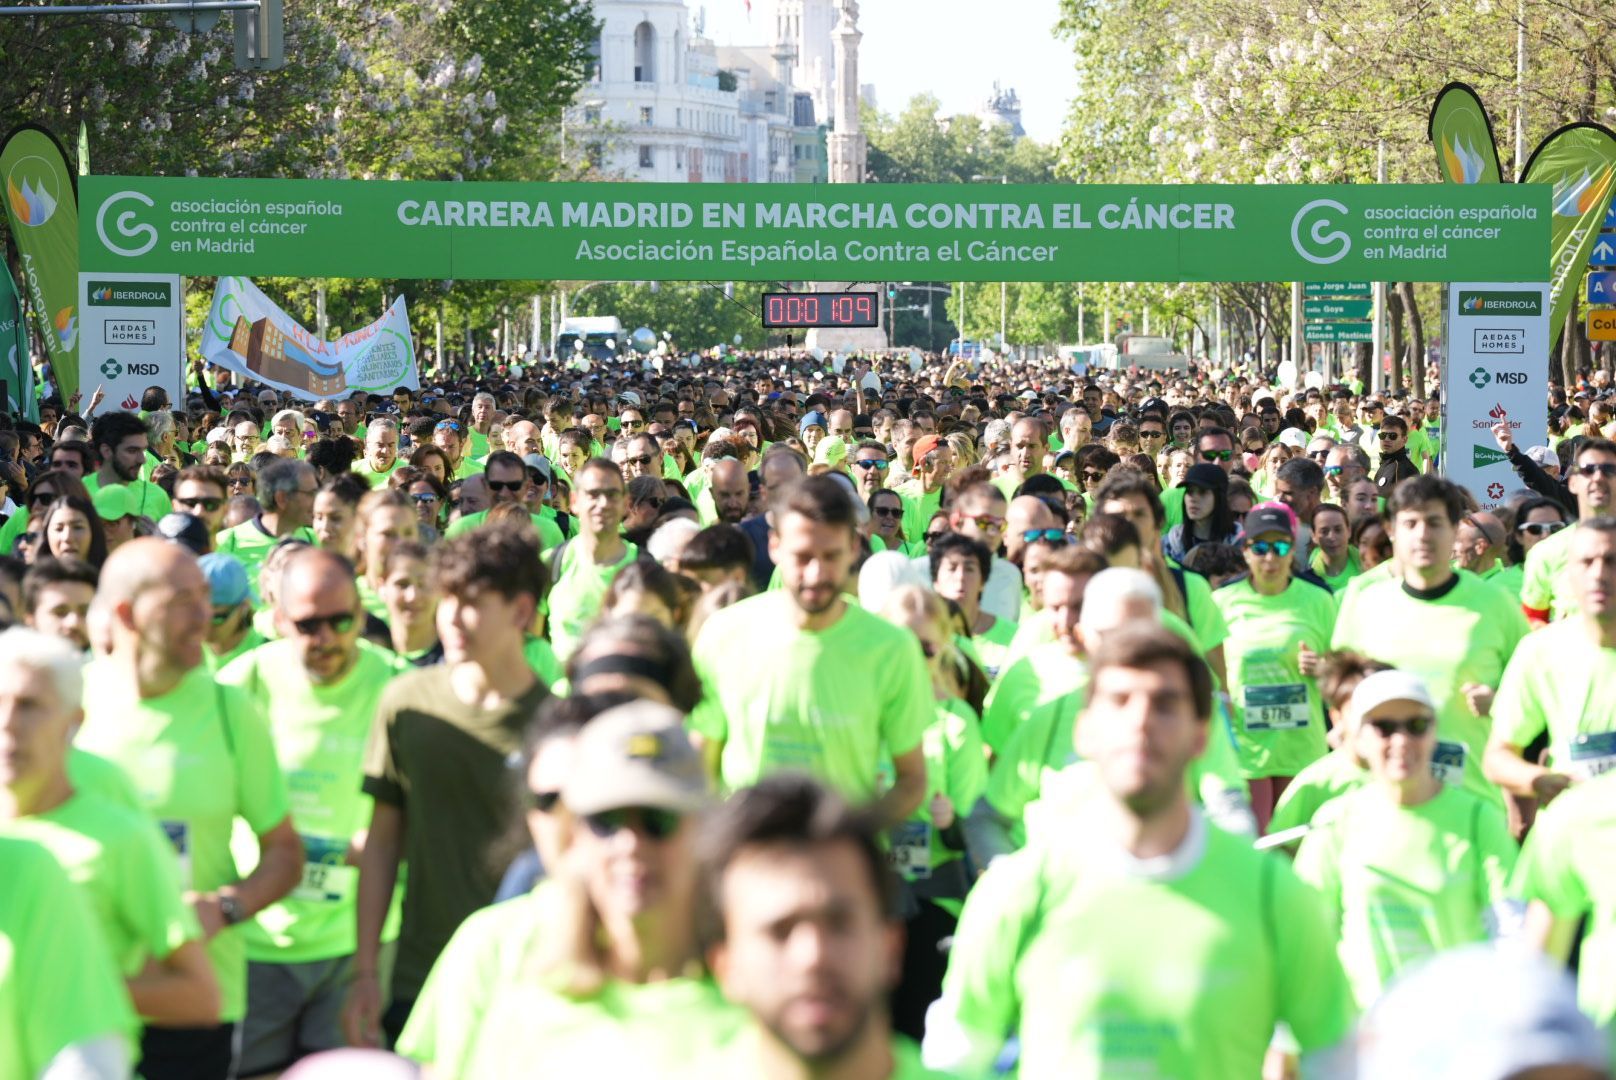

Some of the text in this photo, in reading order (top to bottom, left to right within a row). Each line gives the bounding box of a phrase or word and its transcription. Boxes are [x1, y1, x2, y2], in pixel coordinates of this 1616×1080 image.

[170, 199, 342, 221] asociación española
[397, 197, 1236, 230] CARRERA MADRID EN MARCHA CONTRA EL CÁNCER
[1363, 204, 1537, 225] asociación española
[170, 219, 307, 234] contra el cáncer
[1363, 224, 1501, 239] contra el cáncer
[170, 238, 255, 253] en Madrid
[1363, 244, 1447, 259] en Madrid
[575, 240, 1059, 267] Asociación Española Contra el Cáncer
[1323, 282, 1344, 291] Jorge
[1347, 282, 1367, 290] Juan
[1593, 281, 1604, 293] A
[113, 291, 167, 300] IBERDROLA
[1323, 304, 1344, 313] Goya
[1484, 300, 1537, 309] IBERDROLA
[112, 324, 147, 332] AEDAS
[112, 332, 147, 340] HOMES
[1482, 333, 1517, 341] AEDAS
[127, 363, 160, 376] MSD
[1496, 372, 1528, 385] MSD
[1472, 419, 1522, 429] Santder
